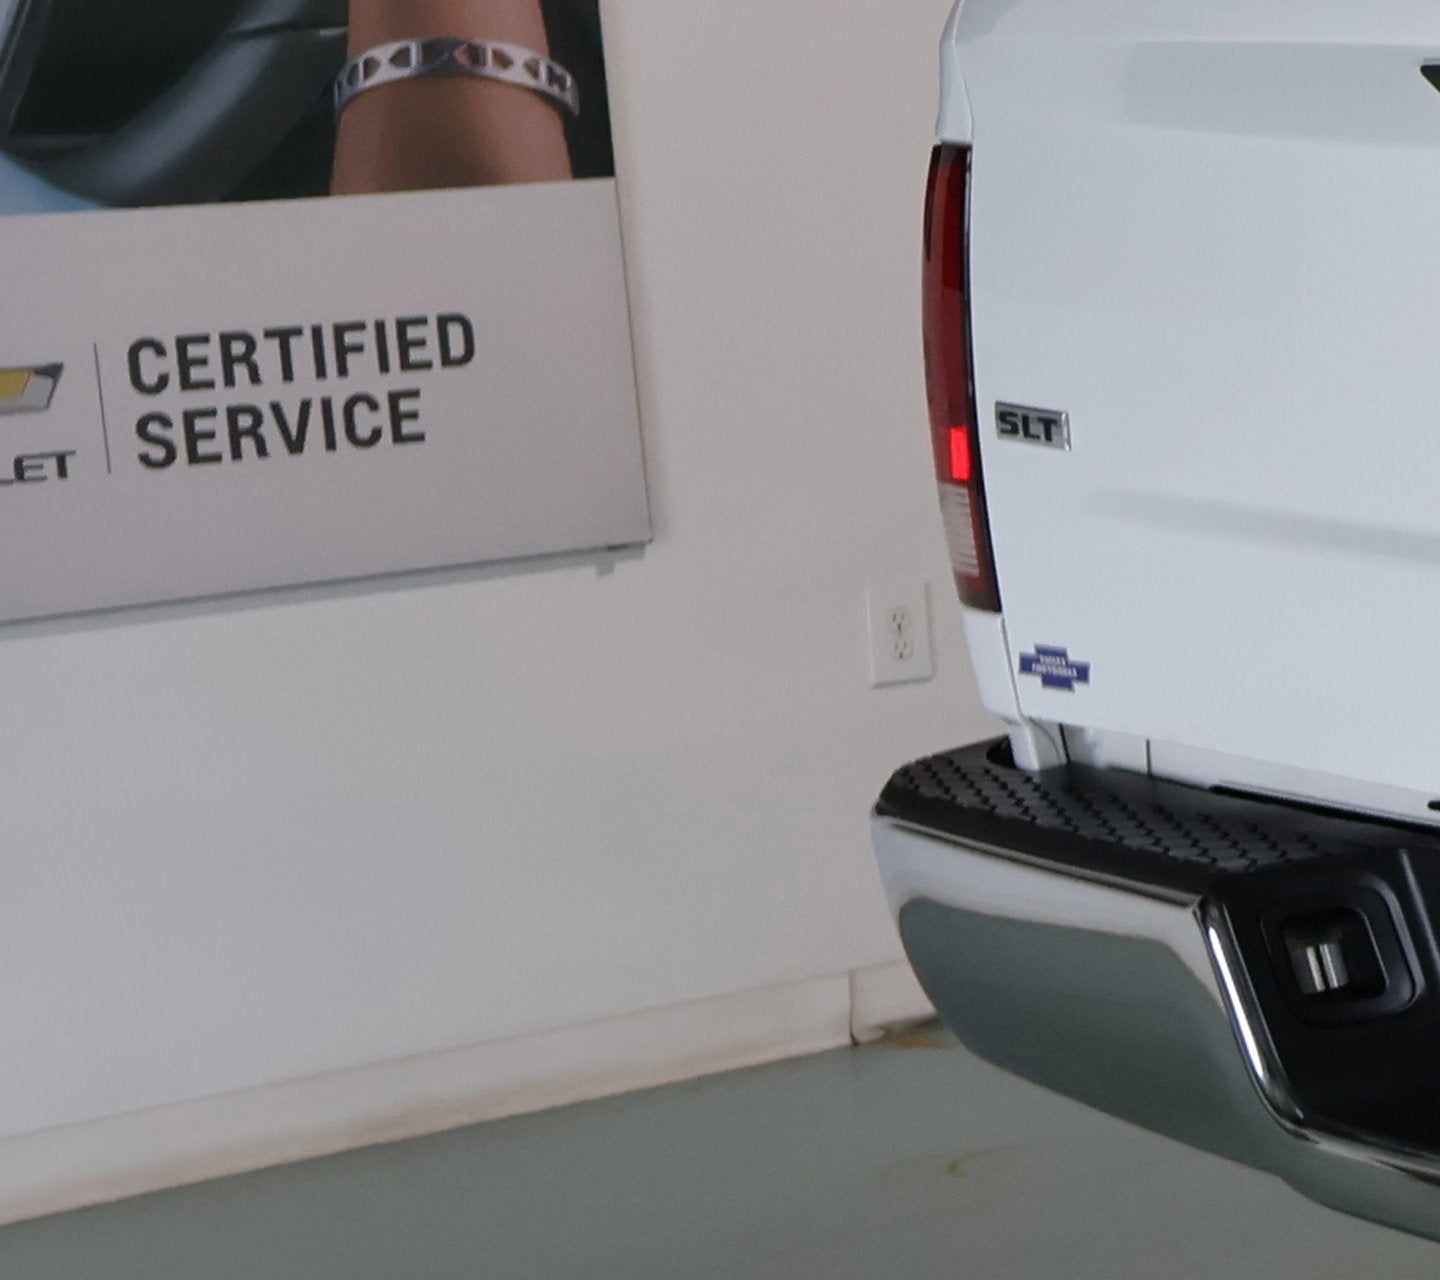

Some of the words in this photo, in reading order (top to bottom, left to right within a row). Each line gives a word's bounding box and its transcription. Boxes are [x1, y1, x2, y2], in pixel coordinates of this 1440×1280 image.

[127, 312, 475, 395] CERTIFIED
[135, 388, 426, 470] SERVICE
[999, 411, 1058, 442] SLT
